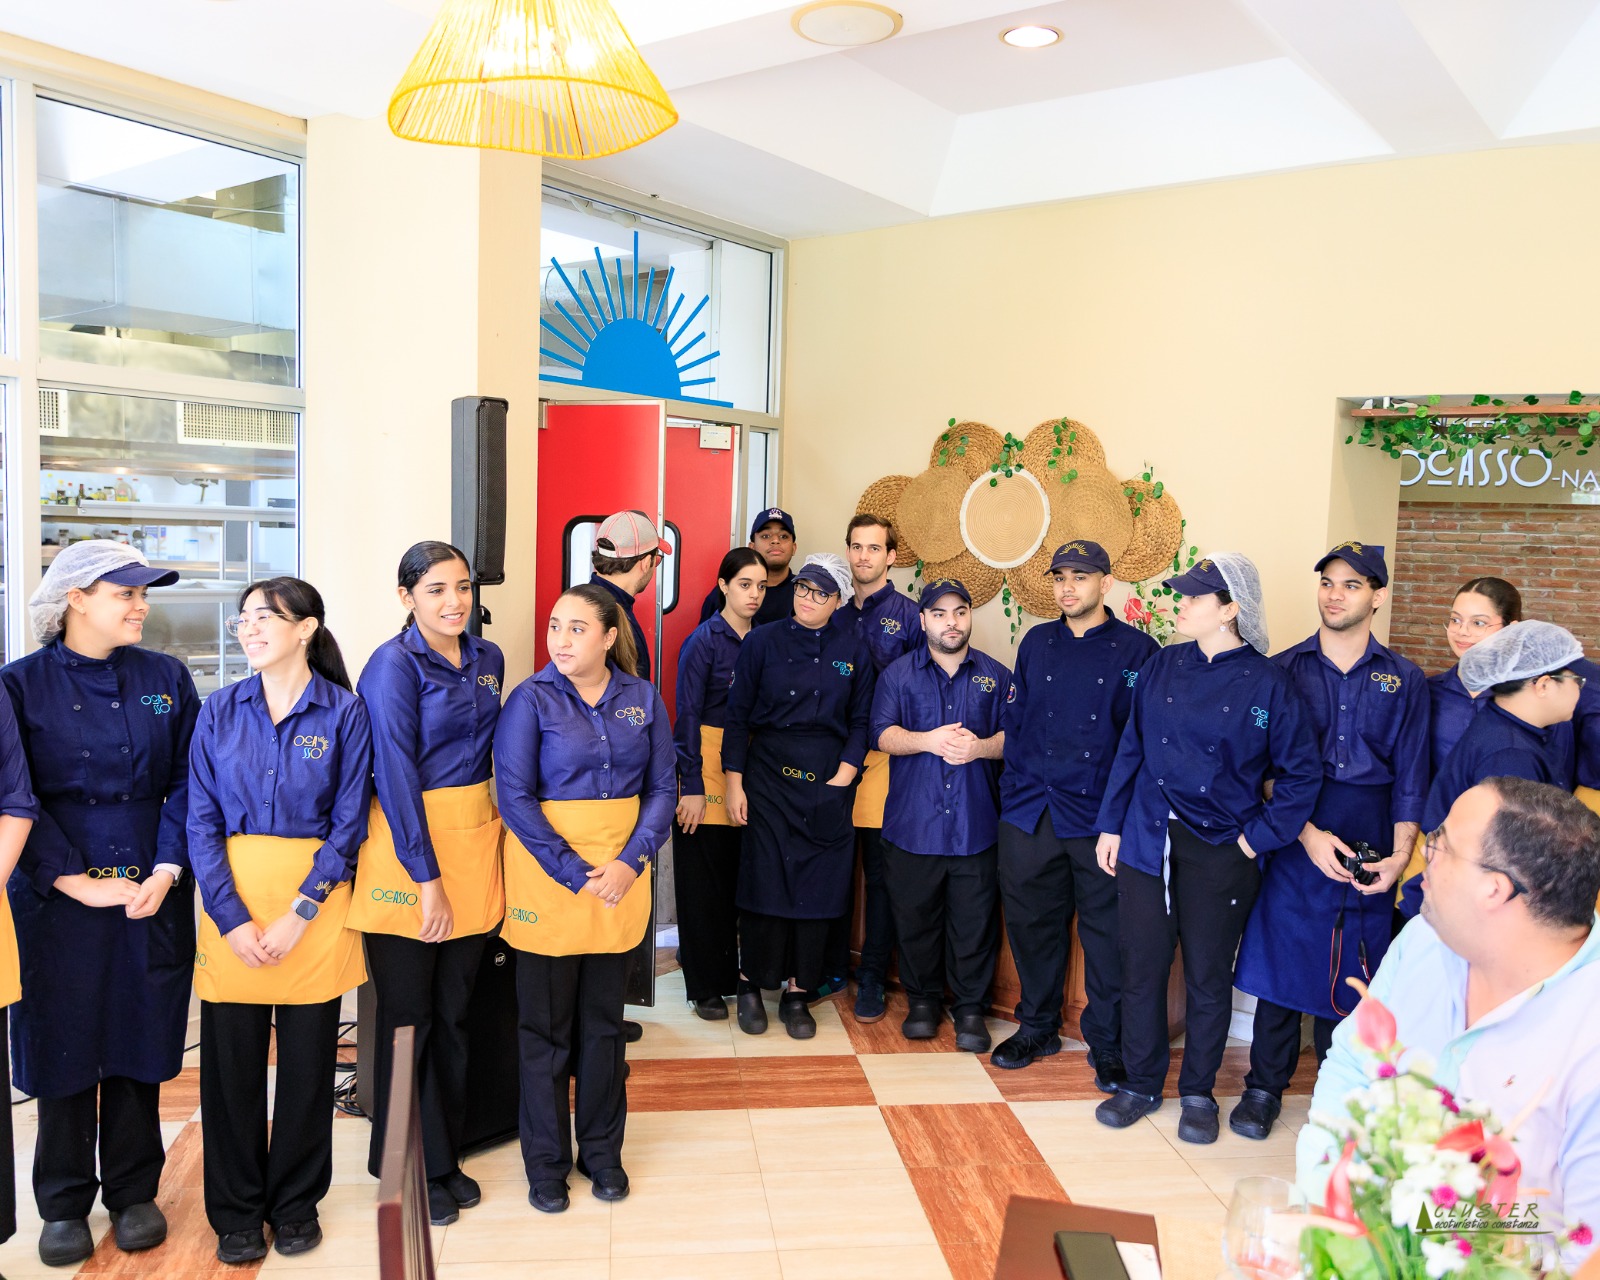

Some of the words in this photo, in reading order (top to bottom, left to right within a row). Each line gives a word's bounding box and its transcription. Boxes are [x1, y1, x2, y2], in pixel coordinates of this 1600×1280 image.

[1370, 672, 1392, 684] OCA
[1380, 682, 1397, 693] SSO
[140, 694, 163, 706] OCA
[153, 703, 171, 715] SSO
[615, 706, 637, 719] OCA
[628, 715, 645, 727] SSO
[293, 734, 318, 748] OCA
[301, 746, 323, 760] SSO
[87, 865, 140, 879] OCASSO
[371, 887, 418, 906] OCASSO
